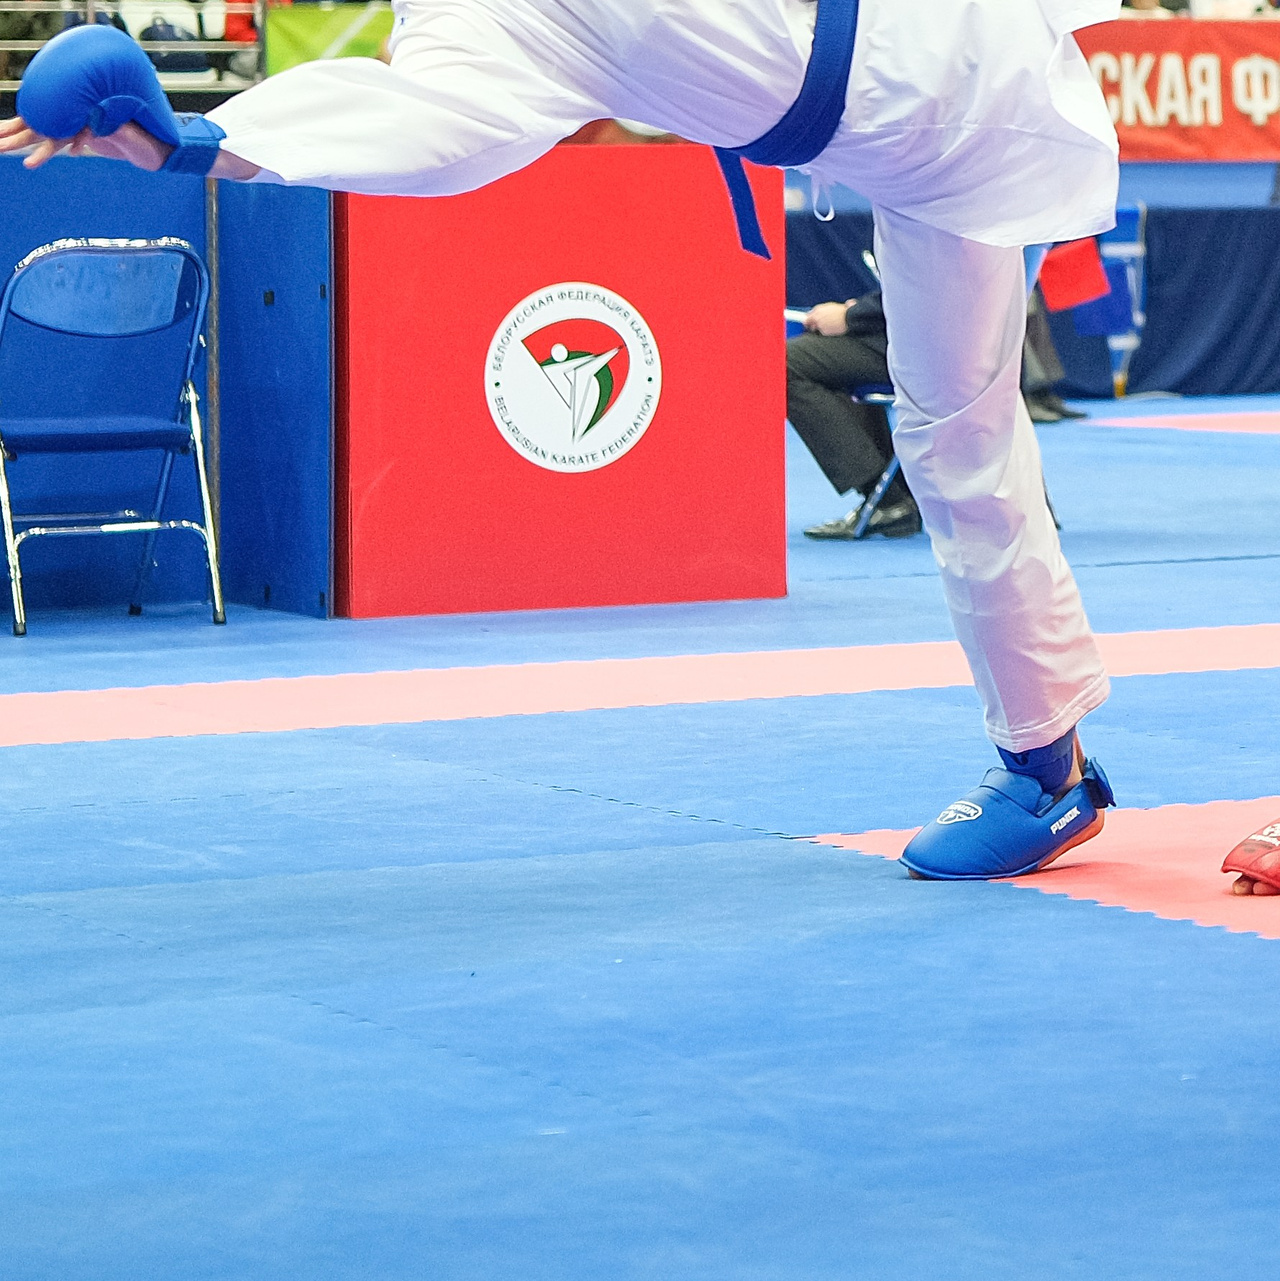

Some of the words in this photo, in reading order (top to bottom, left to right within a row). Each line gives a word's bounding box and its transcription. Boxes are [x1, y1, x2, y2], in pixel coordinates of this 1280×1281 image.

[1089, 52, 1222, 126] СКАЯ
[492, 294, 554, 372] БЕЛОРУССКАЯ
[557, 290, 630, 321] ФЕДЕРАЦИЯ
[630, 319, 655, 367] КАРАТЭ
[494, 395, 548, 461] BELARUSIAN
[550, 451, 600, 465] KARATE
[601, 394, 654, 459] FEDERATION
